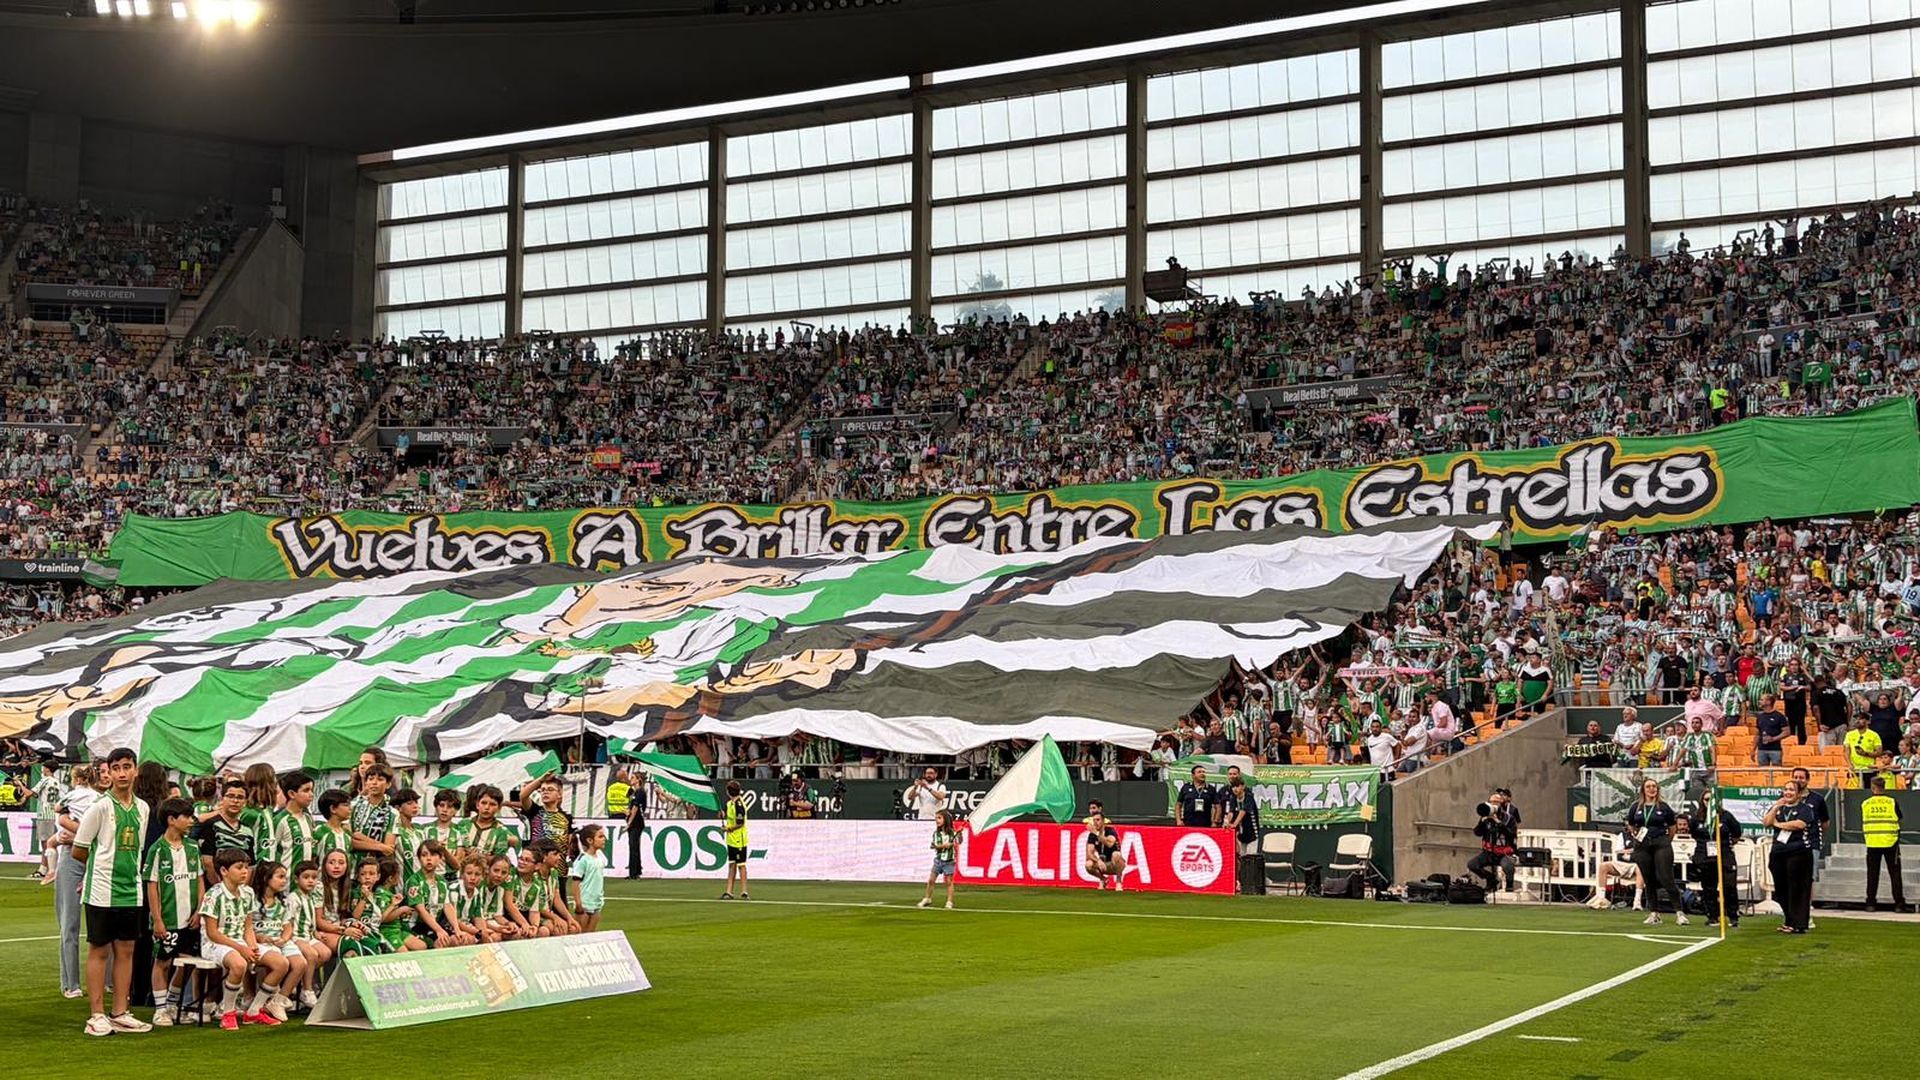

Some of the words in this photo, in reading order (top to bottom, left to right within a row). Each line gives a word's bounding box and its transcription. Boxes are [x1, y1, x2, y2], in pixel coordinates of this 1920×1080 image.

[66, 288, 107, 298] FOREVER
[108, 289, 136, 299] GREEN
[1283, 391, 1300, 402] Real
[1300, 388, 1321, 401] Betis
[841, 421, 884, 432] FOREVER
[274, 515, 546, 575] Vuelves
[575, 511, 643, 570] A
[669, 503, 903, 560] Brillar
[926, 496, 1135, 556] Entre
[1160, 484, 1321, 535] Las
[1347, 443, 1710, 522] Estrellas
[38, 562, 80, 573] trainline
[1905, 588, 1918, 601] 19
[1739, 787, 1760, 796] PEÑA
[1760, 787, 1783, 796] BÉTIC
[1181, 845, 1213, 863] EA
[1179, 863, 1215, 873] SPORTS
[163, 931, 179, 946] 22
[361, 963, 394, 982] HAZTE
[390, 959, 423, 980] SOCIO
[534, 967, 590, 994] VENTAJAS
[587, 961, 637, 987] EXCLUSIVAS
